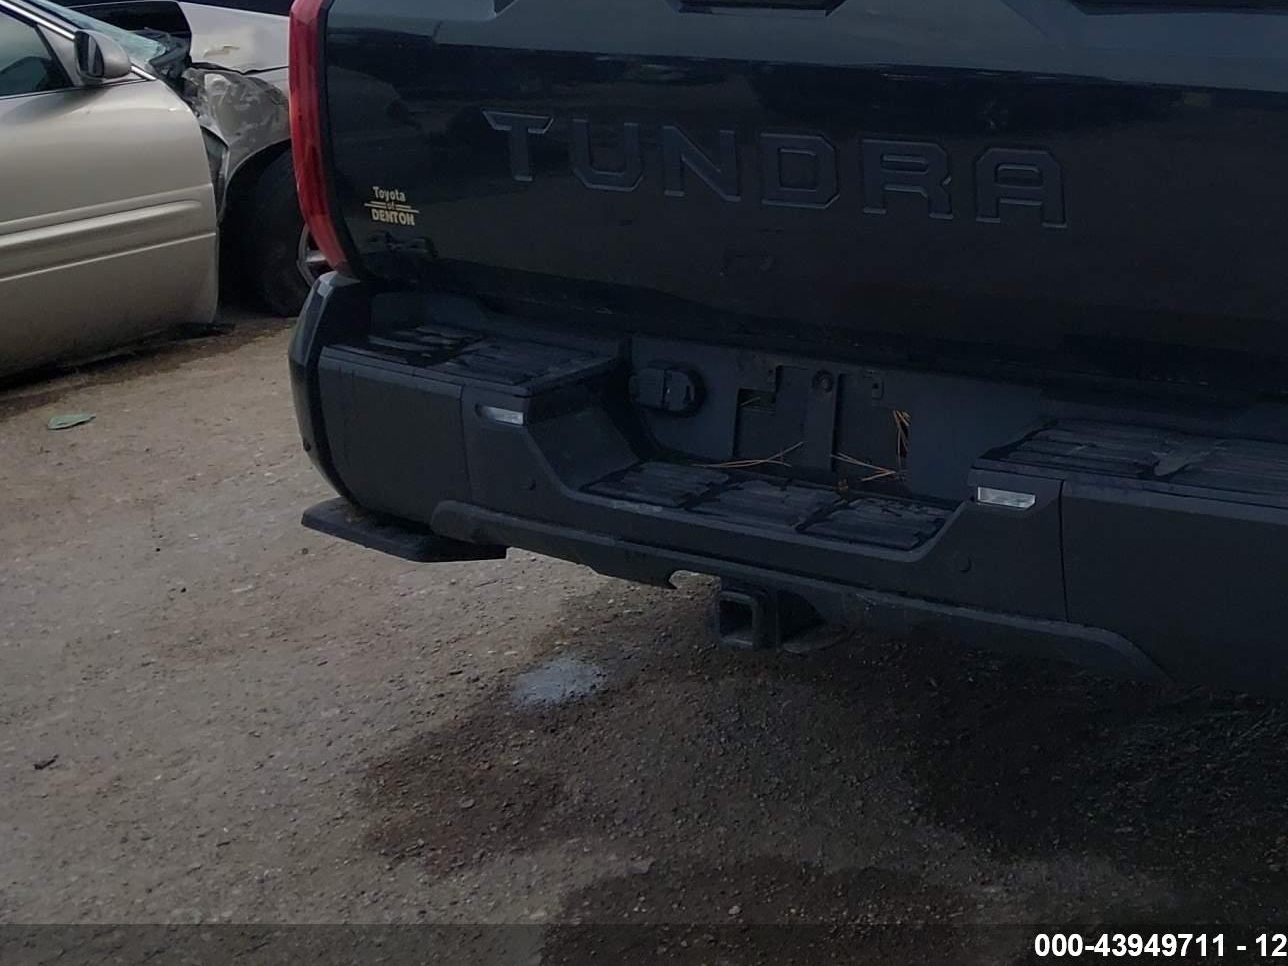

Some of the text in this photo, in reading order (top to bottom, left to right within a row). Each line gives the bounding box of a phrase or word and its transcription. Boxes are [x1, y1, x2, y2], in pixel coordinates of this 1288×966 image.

[481, 107, 1069, 229] TUNDRA
[372, 186, 406, 202] Toyota
[371, 208, 415, 226] DENTON
